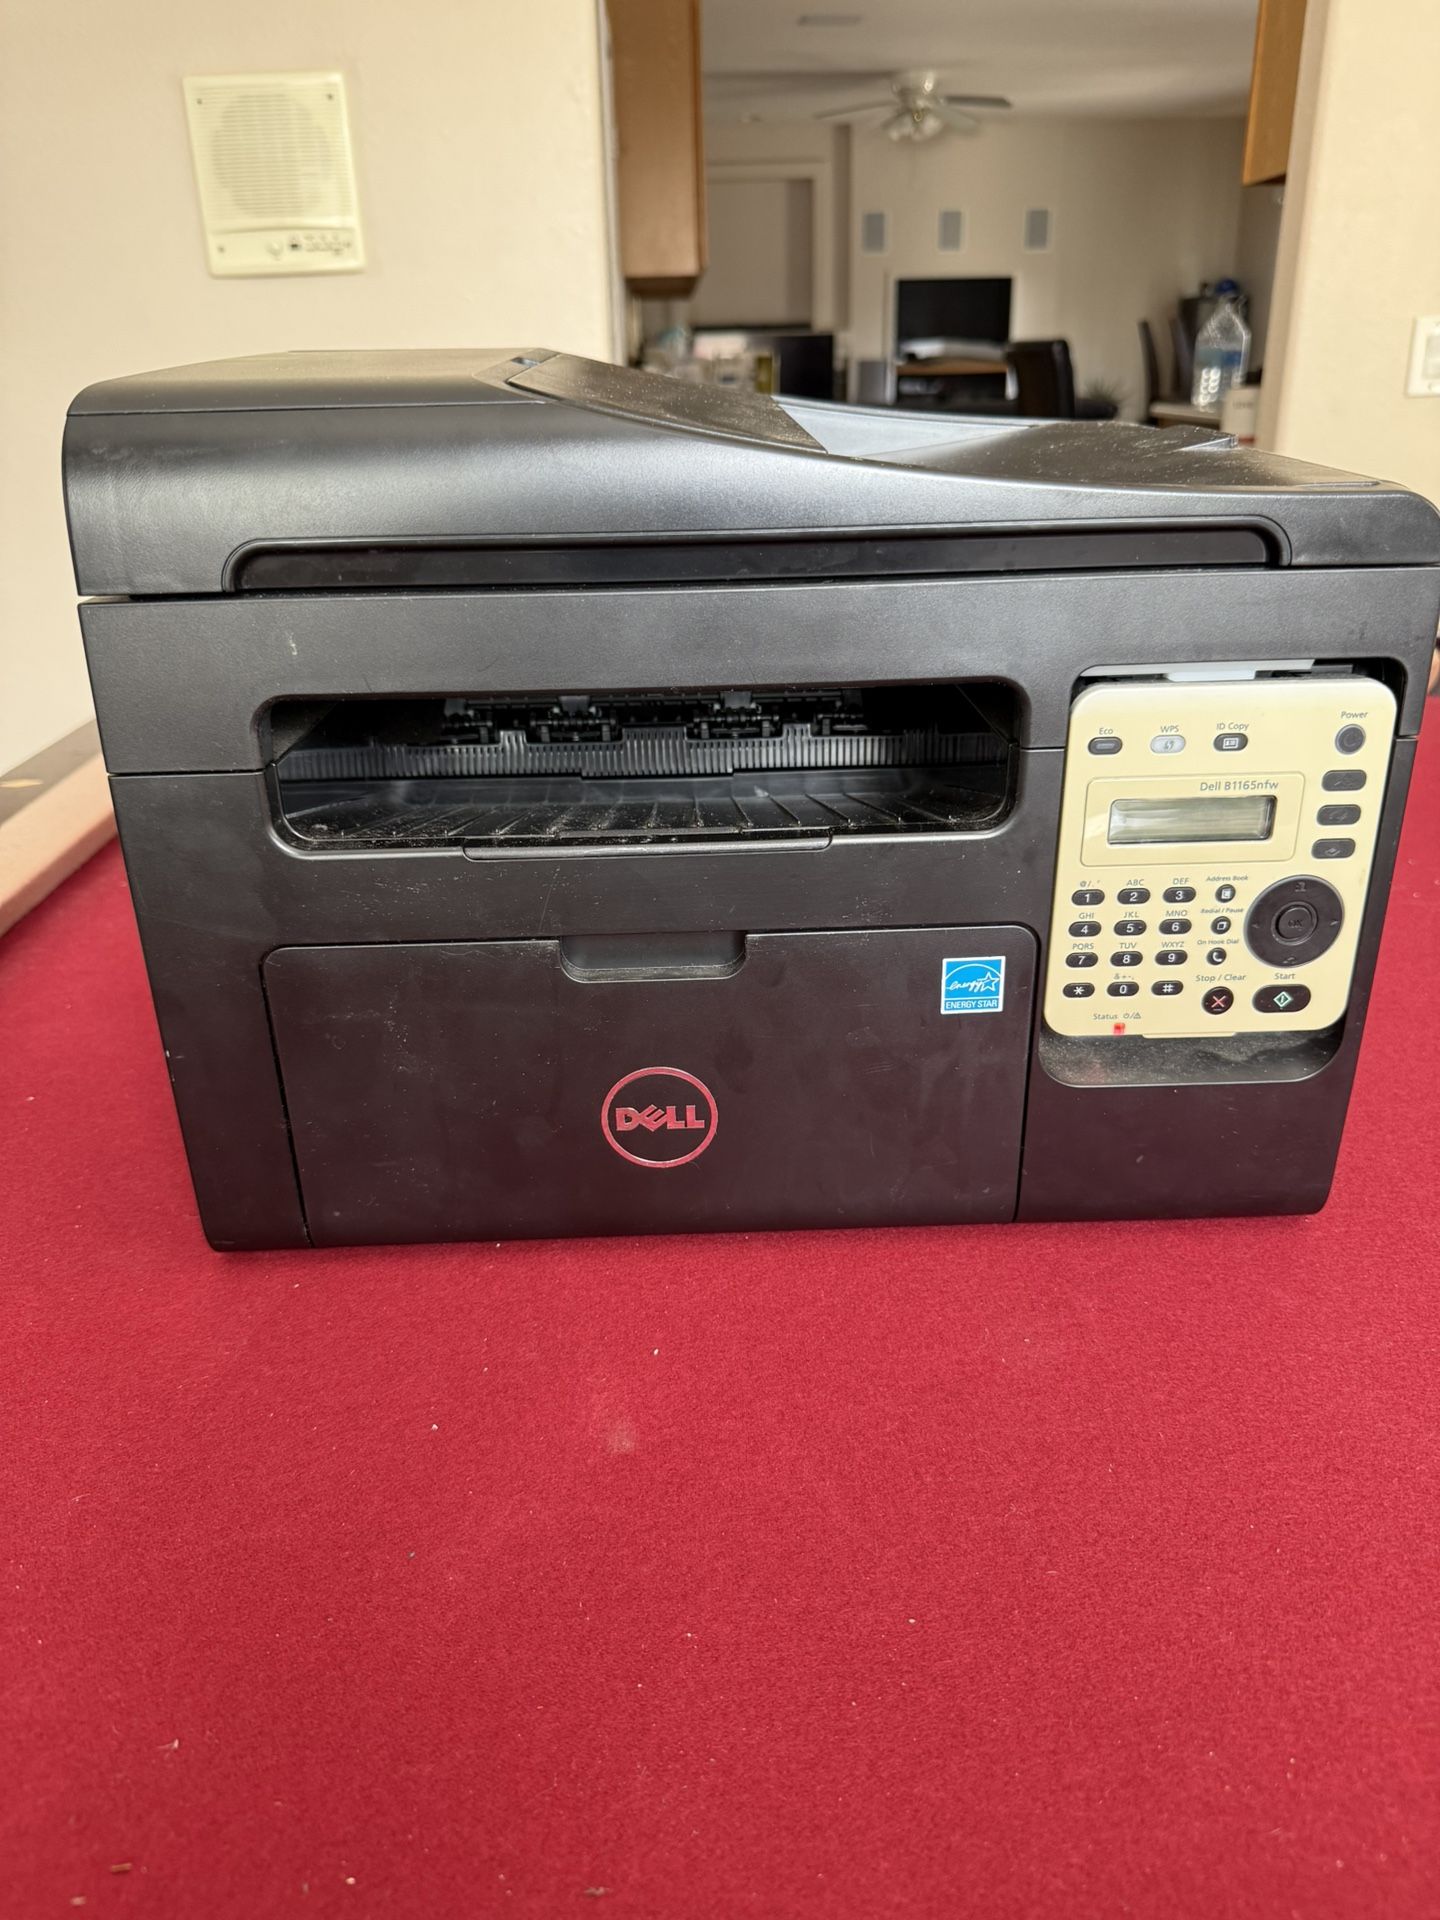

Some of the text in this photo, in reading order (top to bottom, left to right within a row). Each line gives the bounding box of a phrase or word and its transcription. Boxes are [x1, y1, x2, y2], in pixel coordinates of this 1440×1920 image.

[1340, 711, 1368, 719] Power
[1099, 727, 1114, 735] Eco
[1160, 725, 1180, 733] WPS
[1216, 722, 1249, 732] ID Copy
[1199, 780, 1279, 791] Dell B1165nfw
[1084, 893, 1091, 903] 1
[1129, 892, 1138, 902] 2
[1175, 890, 1184, 900] 3
[1080, 924, 1089, 934] 4
[1126, 923, 1134, 933] 5
[1171, 922, 1180, 932] 6
[1072, 943, 1094, 951] PQRS
[1078, 955, 1086, 965] 7
[1122, 954, 1131, 964] 8
[1167, 953, 1176, 963] 9
[1195, 975, 1216, 983] Stop
[1224, 973, 1247, 981] Clear
[1274, 972, 1297, 980] Start
[1119, 984, 1127, 994] 0
[1161, 983, 1174, 993] #
[945, 999, 998, 1009] ENERGY STAR
[615, 1104, 705, 1132] DELL
